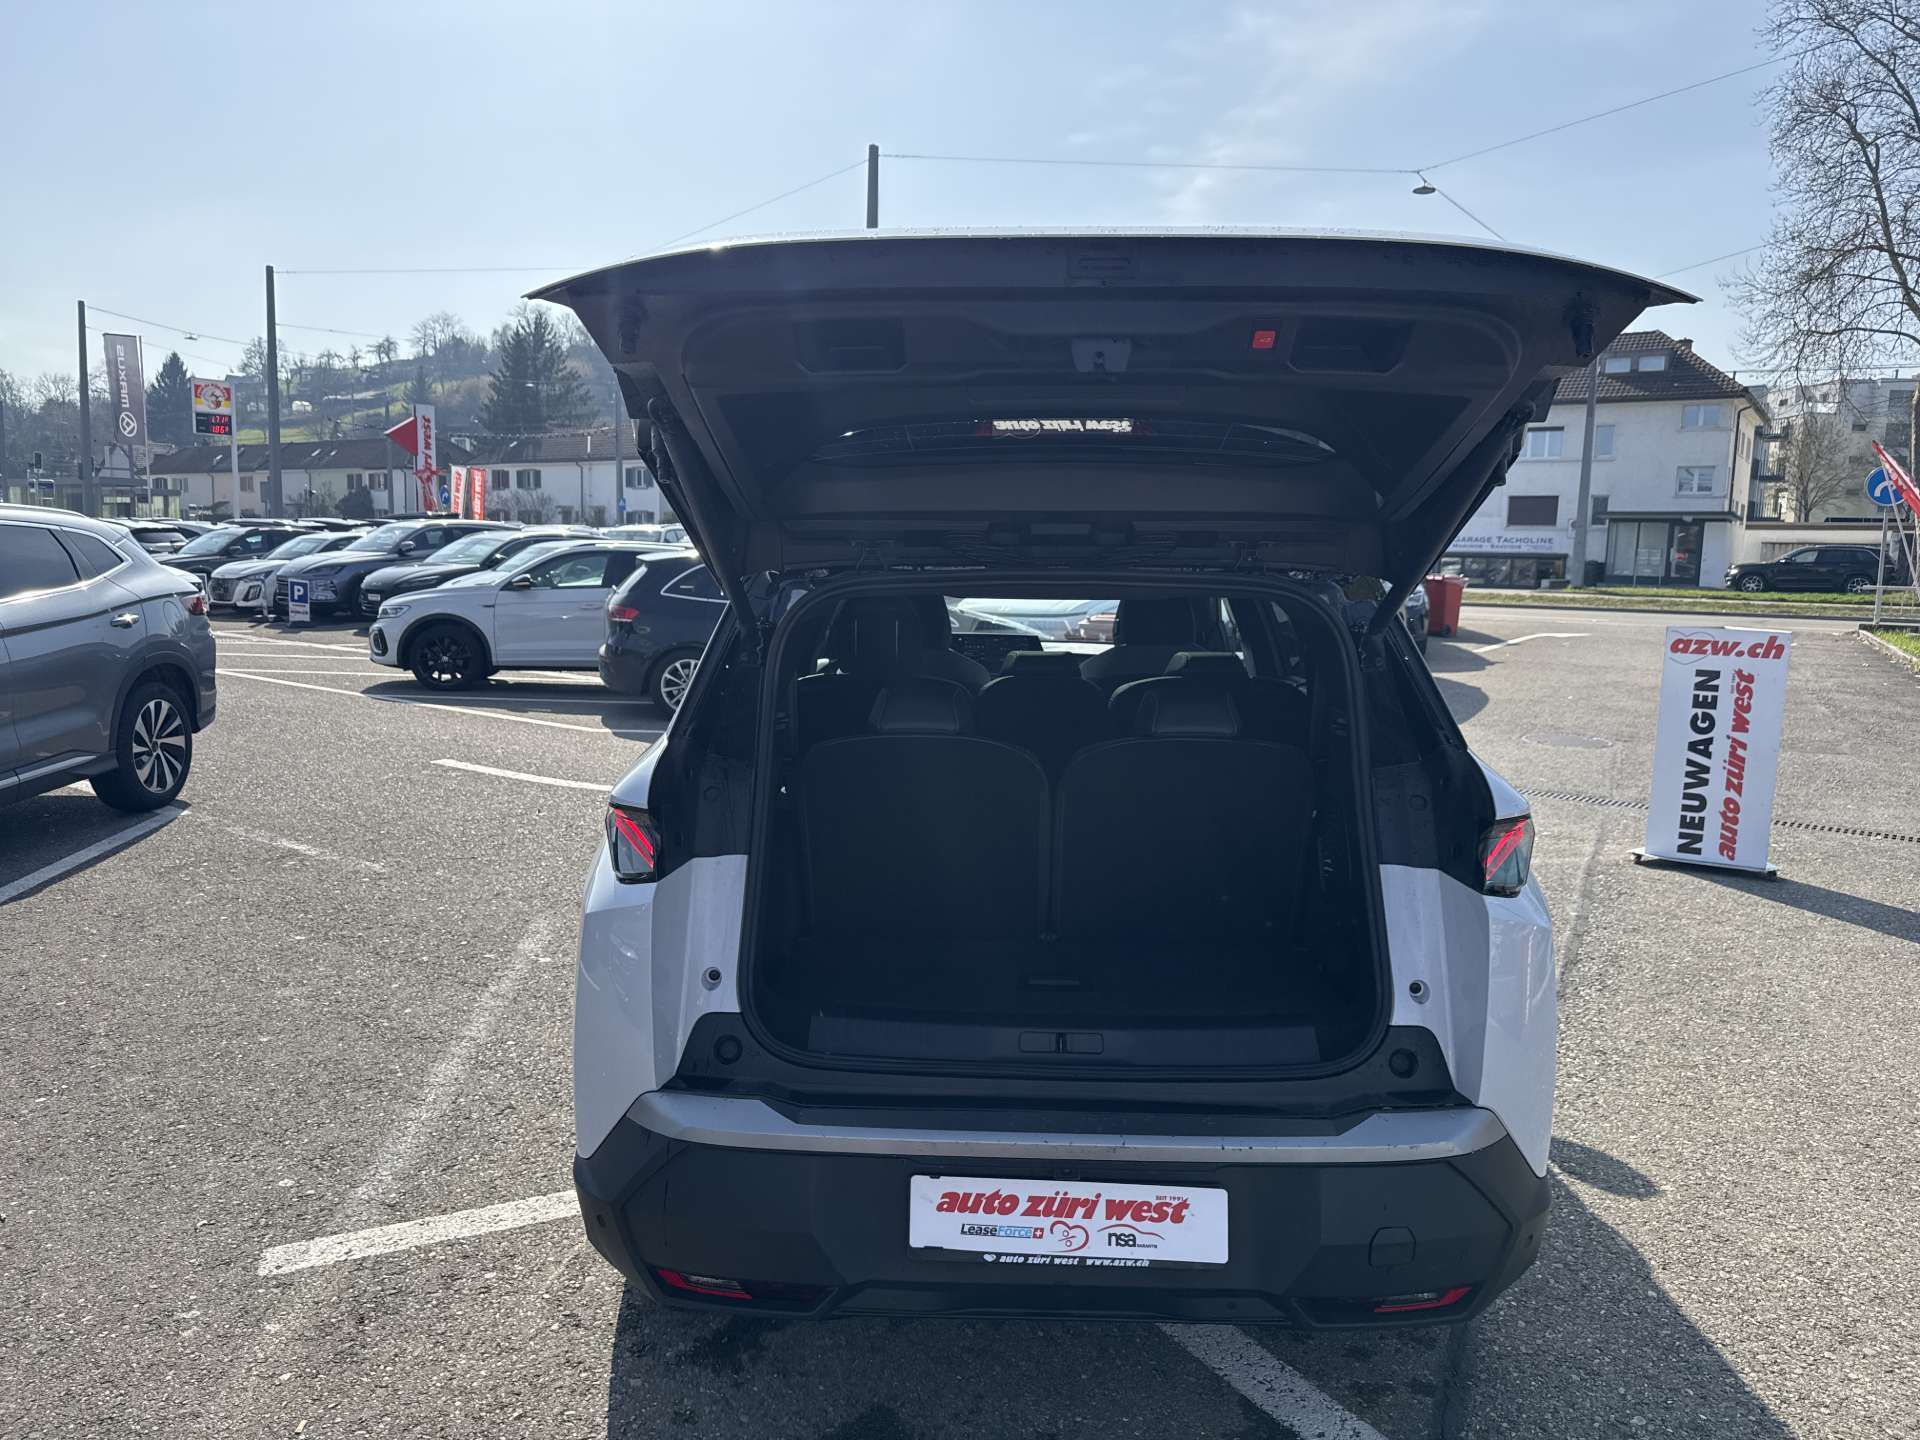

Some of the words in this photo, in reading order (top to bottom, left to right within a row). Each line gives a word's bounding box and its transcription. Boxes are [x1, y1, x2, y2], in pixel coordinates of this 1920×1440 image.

[1496, 535, 1554, 545] TACHOLINE
[294, 585, 304, 600] P
[1670, 636, 1785, 660] azw.ch
[1731, 668, 1755, 733] west
[1677, 669, 1721, 856] NEUWAGEN
[1723, 735, 1748, 797] züri
[1718, 797, 1741, 861] auto
[936, 1189, 1020, 1215] auto
[1020, 1191, 1101, 1219] züri
[1105, 1198, 1190, 1224] west
[960, 1223, 1032, 1239] LeaseForce
[1108, 1232, 1136, 1247] nsa
[999, 1255, 1024, 1263] auto
[1027, 1255, 1051, 1264] züri
[1053, 1257, 1079, 1265] west
[1086, 1258, 1150, 1267] www.azw.ch
